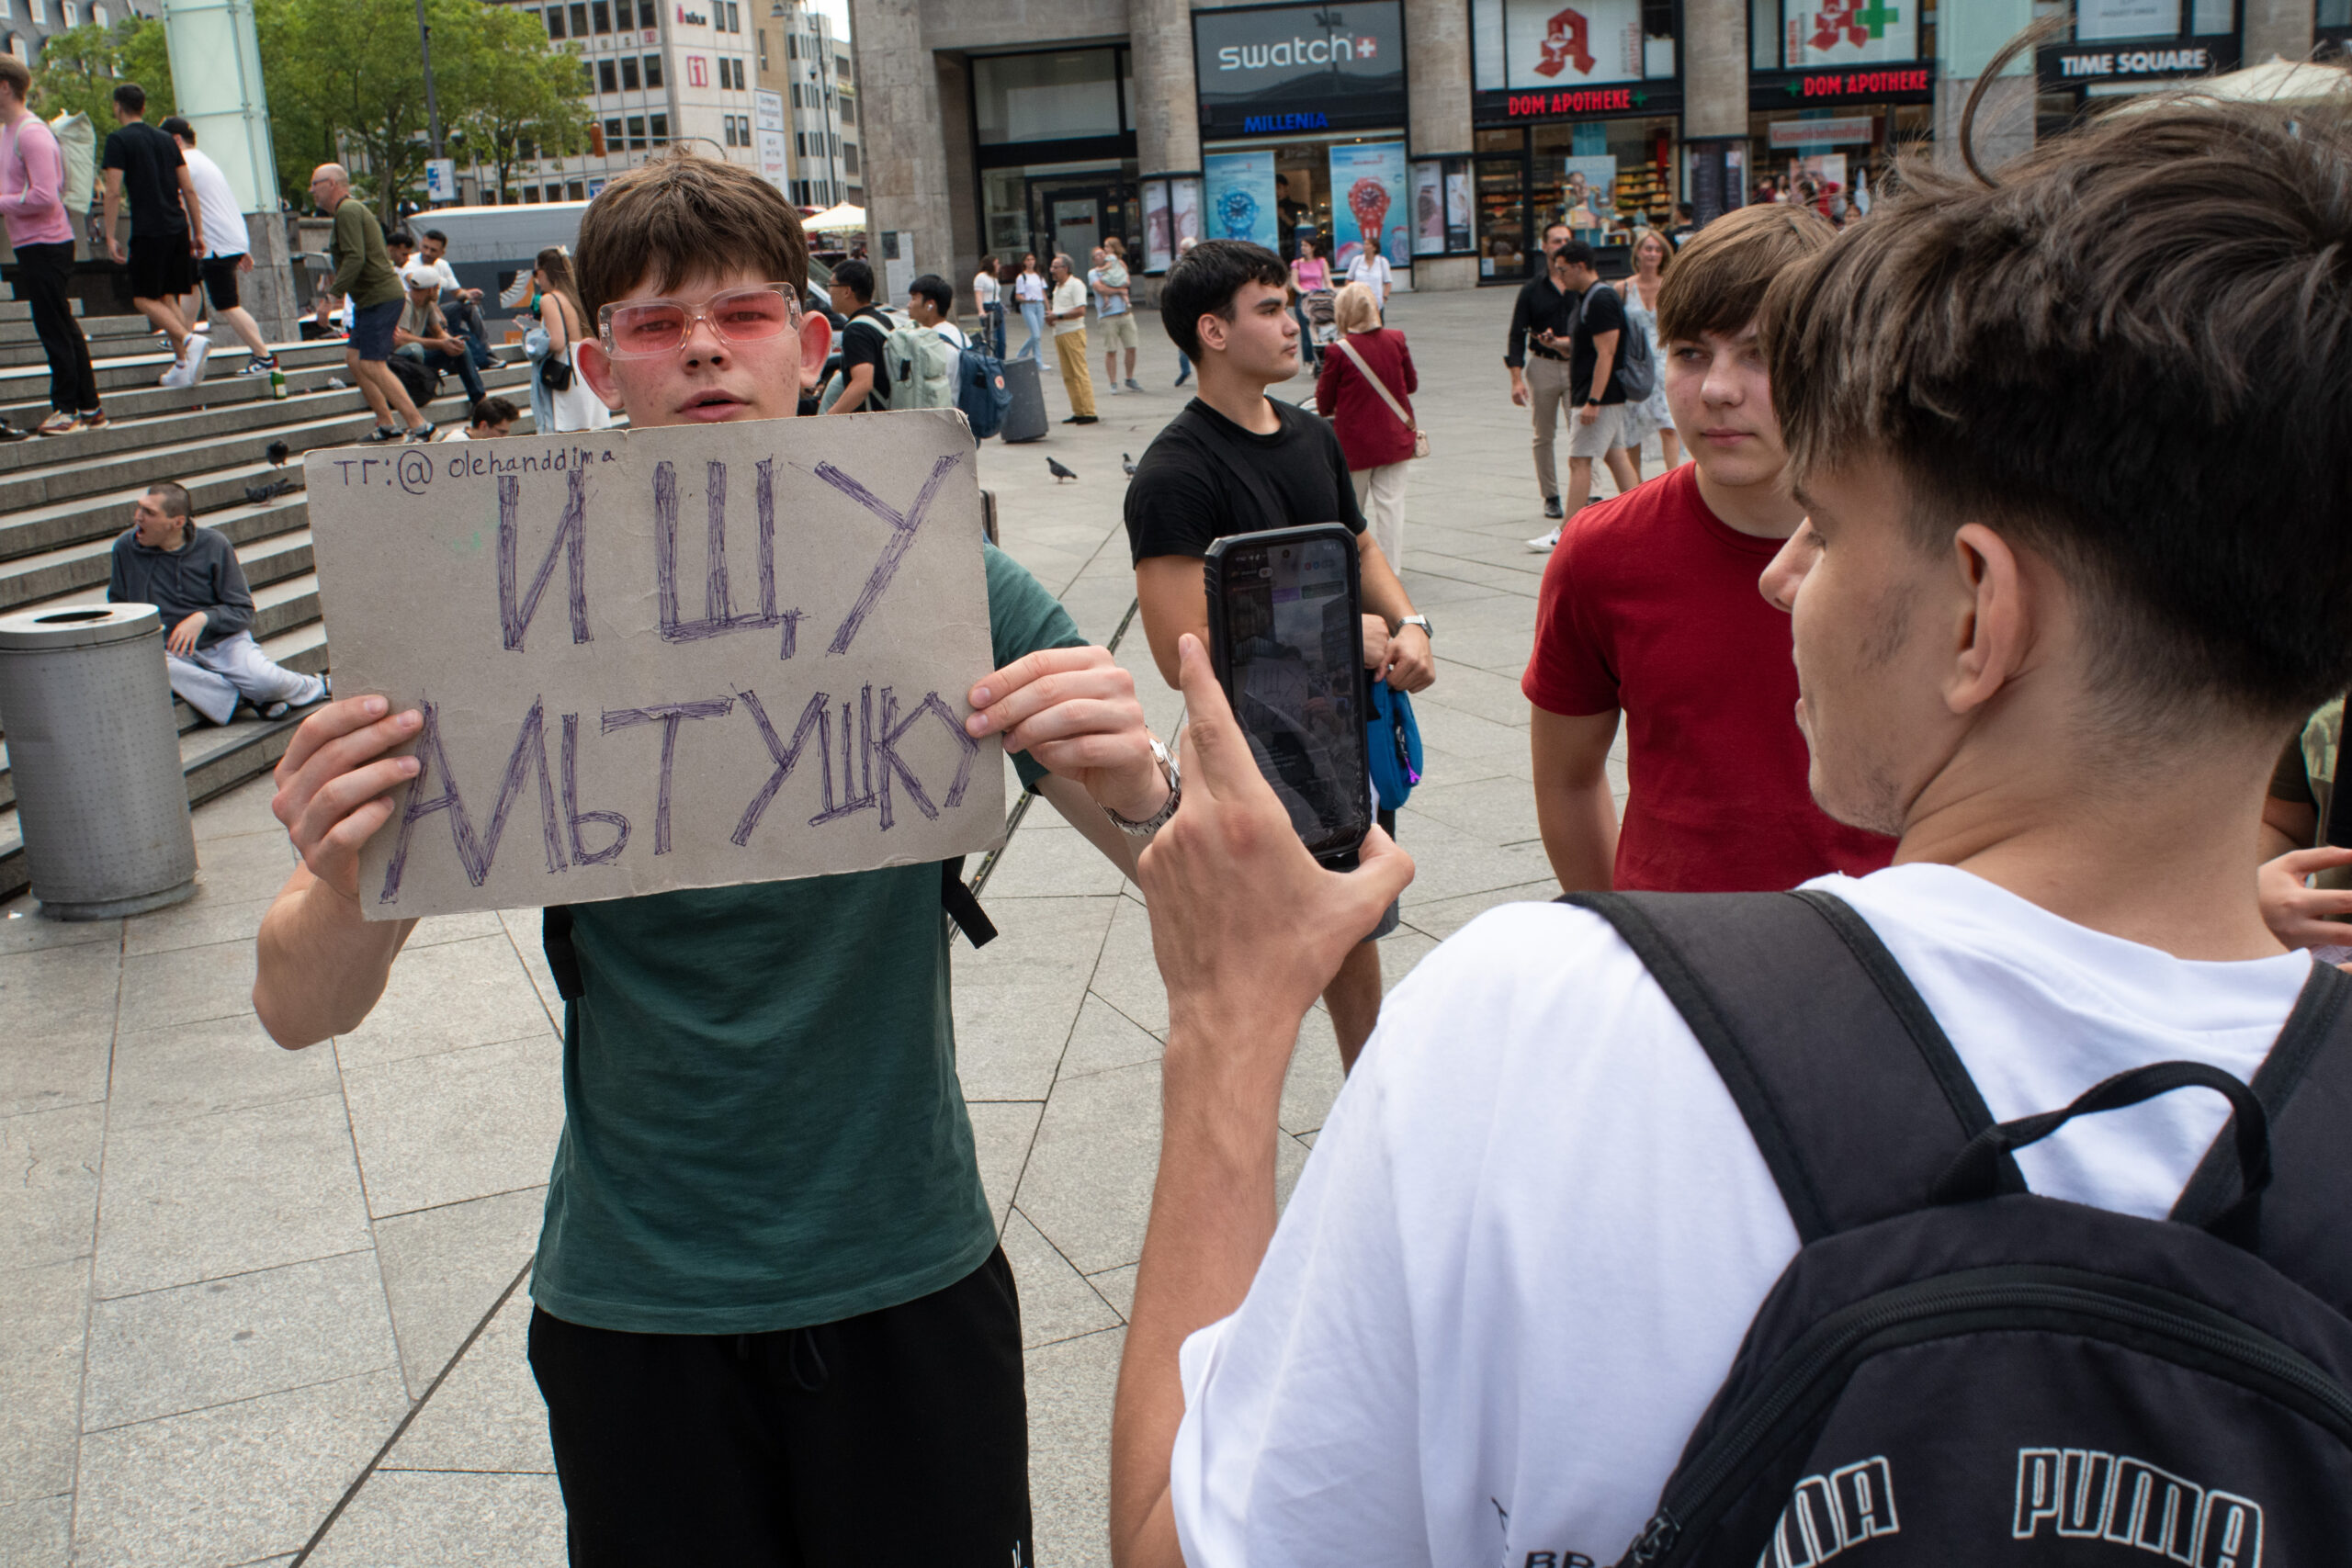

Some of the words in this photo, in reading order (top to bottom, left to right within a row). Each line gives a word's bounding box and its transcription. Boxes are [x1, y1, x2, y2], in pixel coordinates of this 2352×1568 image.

[1218, 34, 1352, 71] swatch
[2060, 54, 2114, 76] TIME
[2116, 49, 2208, 73] SQUARE
[1804, 75, 1842, 96] DOM
[1847, 70, 1928, 94] APOTHEKE
[1509, 95, 1546, 116] DOM
[1551, 89, 1631, 114] APOTHEKE
[1244, 111, 1329, 133] MILLENIA
[497, 451, 964, 660] ИЩУ
[2013, 1448, 2263, 1568] PUMA
